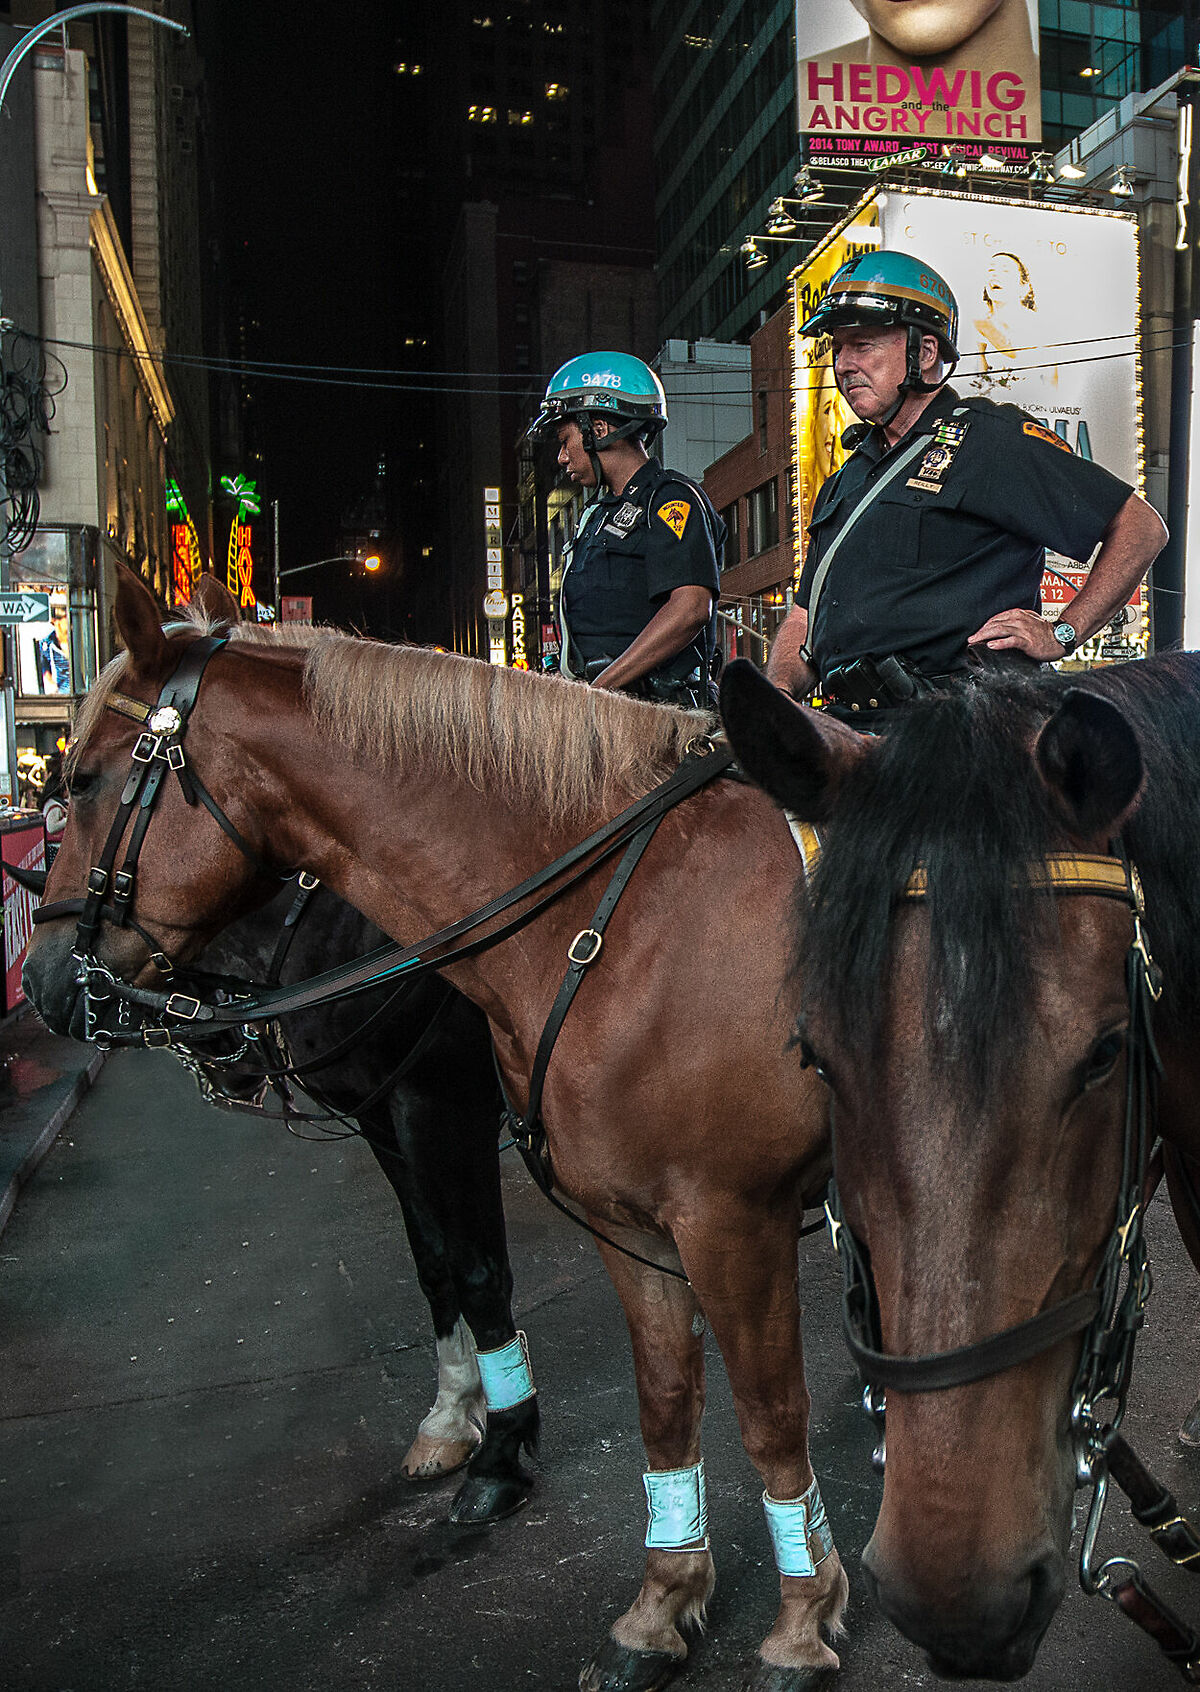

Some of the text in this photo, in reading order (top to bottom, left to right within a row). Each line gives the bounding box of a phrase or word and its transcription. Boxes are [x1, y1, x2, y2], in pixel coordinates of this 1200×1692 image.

[807, 61, 1026, 111] HEDWIG
[901, 99, 950, 112] and the
[808, 104, 1027, 138] ANGRY INCH
[809, 137, 833, 150] 2014
[836, 138, 861, 152] TONY
[864, 140, 899, 153] AWARD
[818, 157, 849, 166] BELASCO
[873, 149, 922, 170] LAMAR
[581, 373, 621, 388] 9478
[1051, 589, 1064, 600] 12
[3, 603, 35, 614] WAY
[511, 594, 526, 648] PARK
